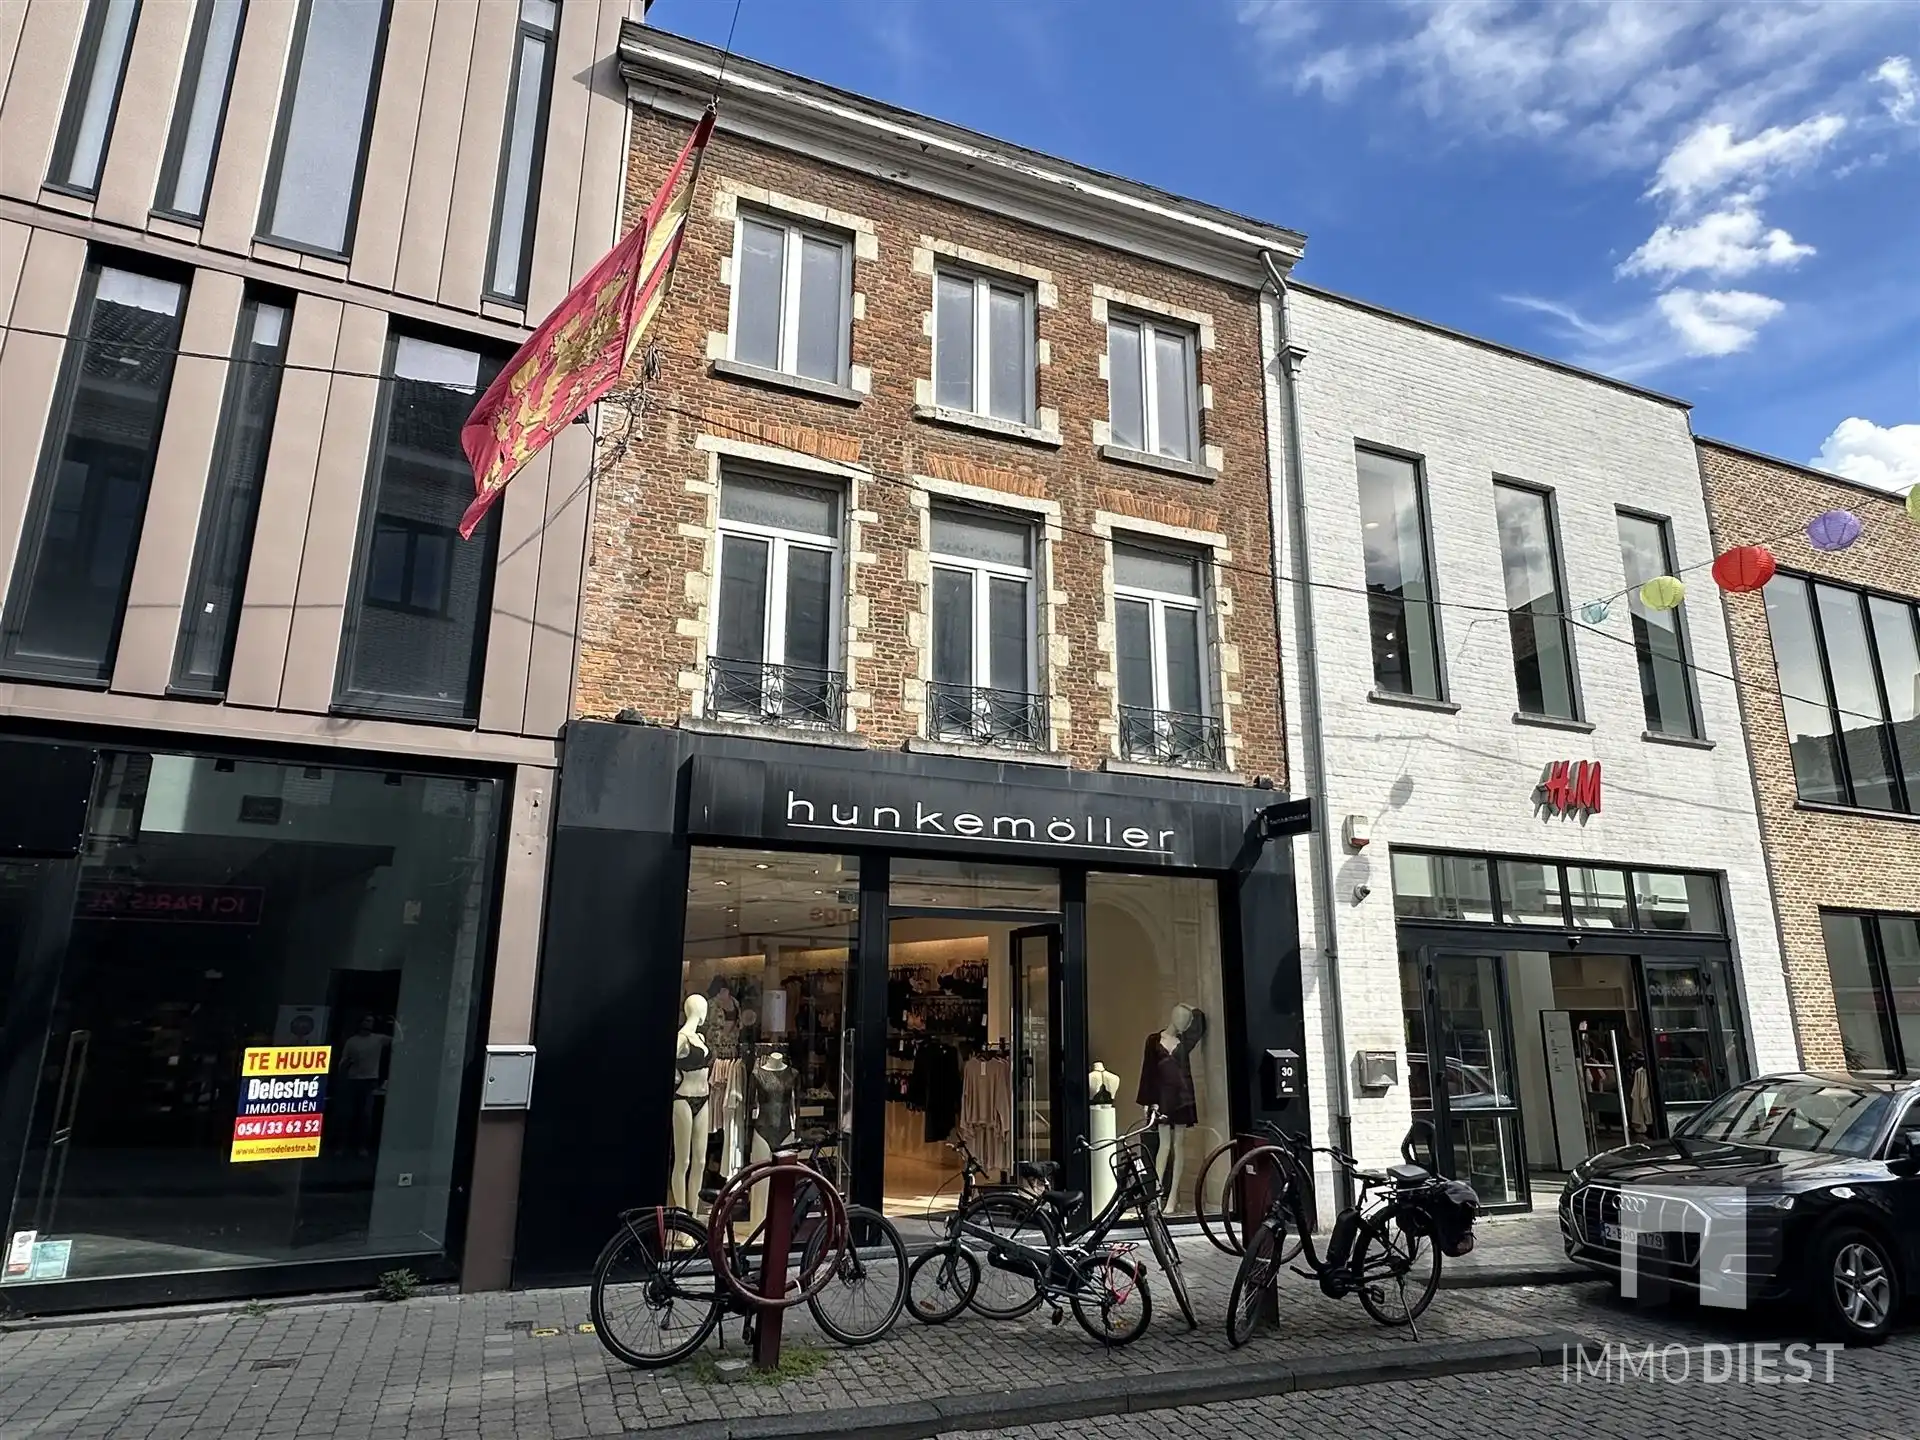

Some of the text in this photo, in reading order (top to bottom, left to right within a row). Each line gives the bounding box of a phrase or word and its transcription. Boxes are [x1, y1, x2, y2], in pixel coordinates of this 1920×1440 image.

[786, 790, 1175, 849] hunkemöller
[247, 1051, 327, 1070] TE HUUR
[1281, 1067, 1293, 1076] 30
[247, 1076, 320, 1100] Delestré
[245, 1100, 317, 1114] IMMOBILIËN
[237, 1119, 320, 1136] 054/33 62 52
[235, 1143, 316, 1156] www.immodelestre.be
